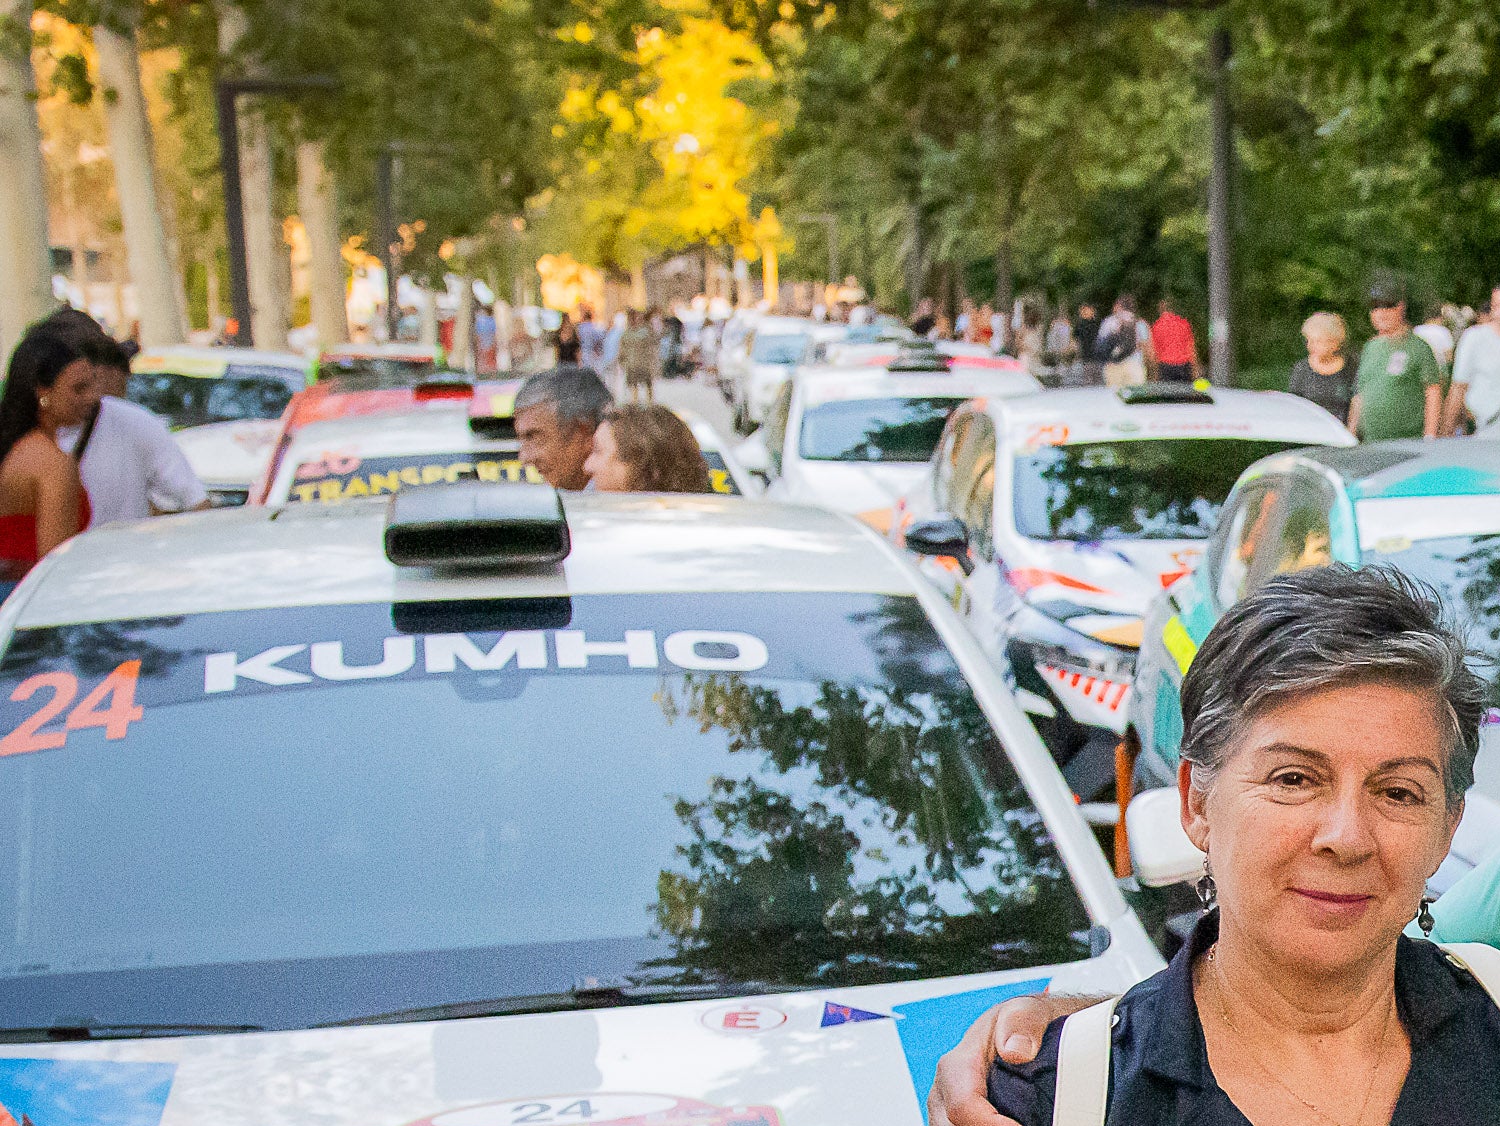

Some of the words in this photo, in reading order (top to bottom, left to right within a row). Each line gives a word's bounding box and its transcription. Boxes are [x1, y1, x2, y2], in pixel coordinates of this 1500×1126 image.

[205, 629, 769, 695] KUMHO
[0, 658, 144, 758] 24
[510, 1099, 599, 1124] 24
